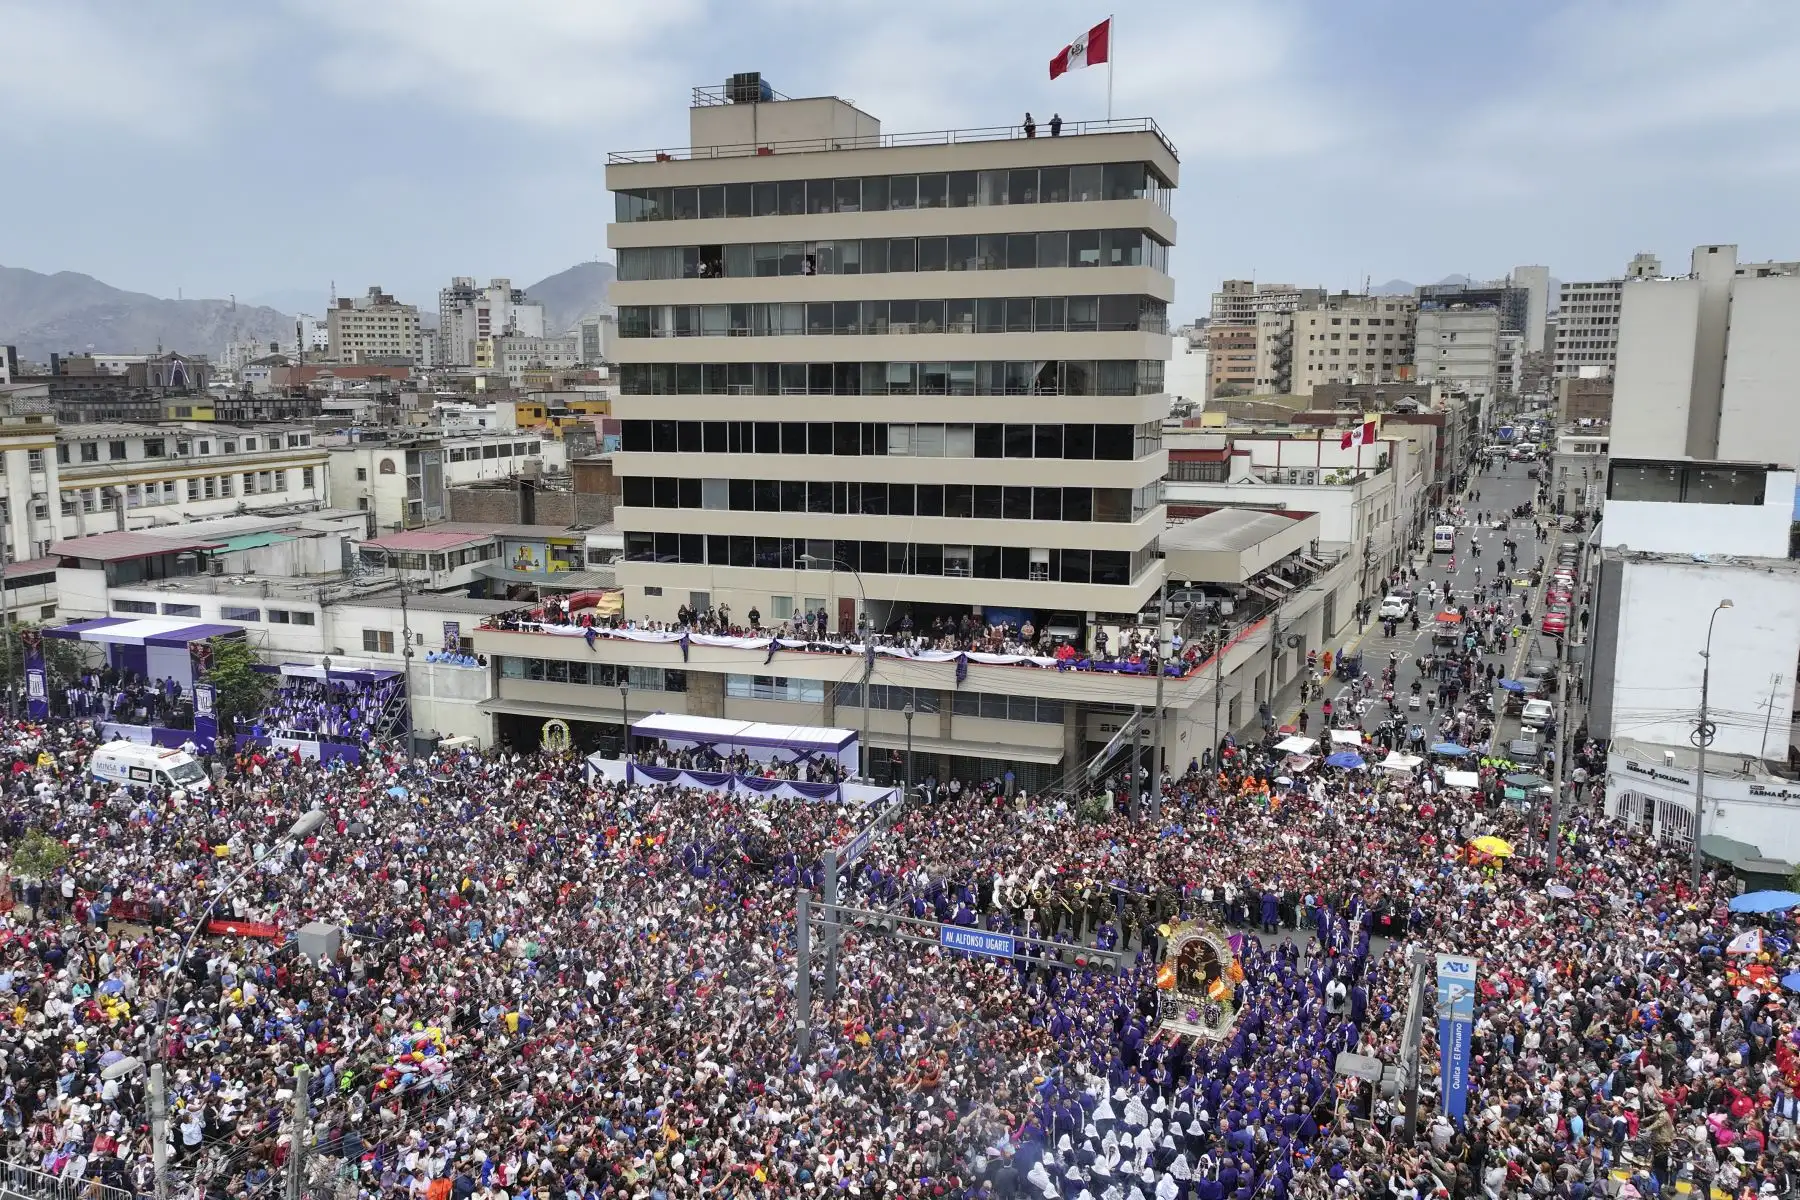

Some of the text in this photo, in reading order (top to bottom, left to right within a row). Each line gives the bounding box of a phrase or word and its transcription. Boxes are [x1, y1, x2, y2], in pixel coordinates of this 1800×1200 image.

[96, 761, 117, 771] MINSA
[1627, 765, 1647, 775] FARMA
[1749, 789, 1776, 797] FARMA
[945, 931, 1009, 952] AV. ALFONSO UGARTE
[1442, 961, 1470, 973] ATU
[1453, 1023, 1463, 1052] Peruano
[1452, 1066, 1460, 1090] Quilca
